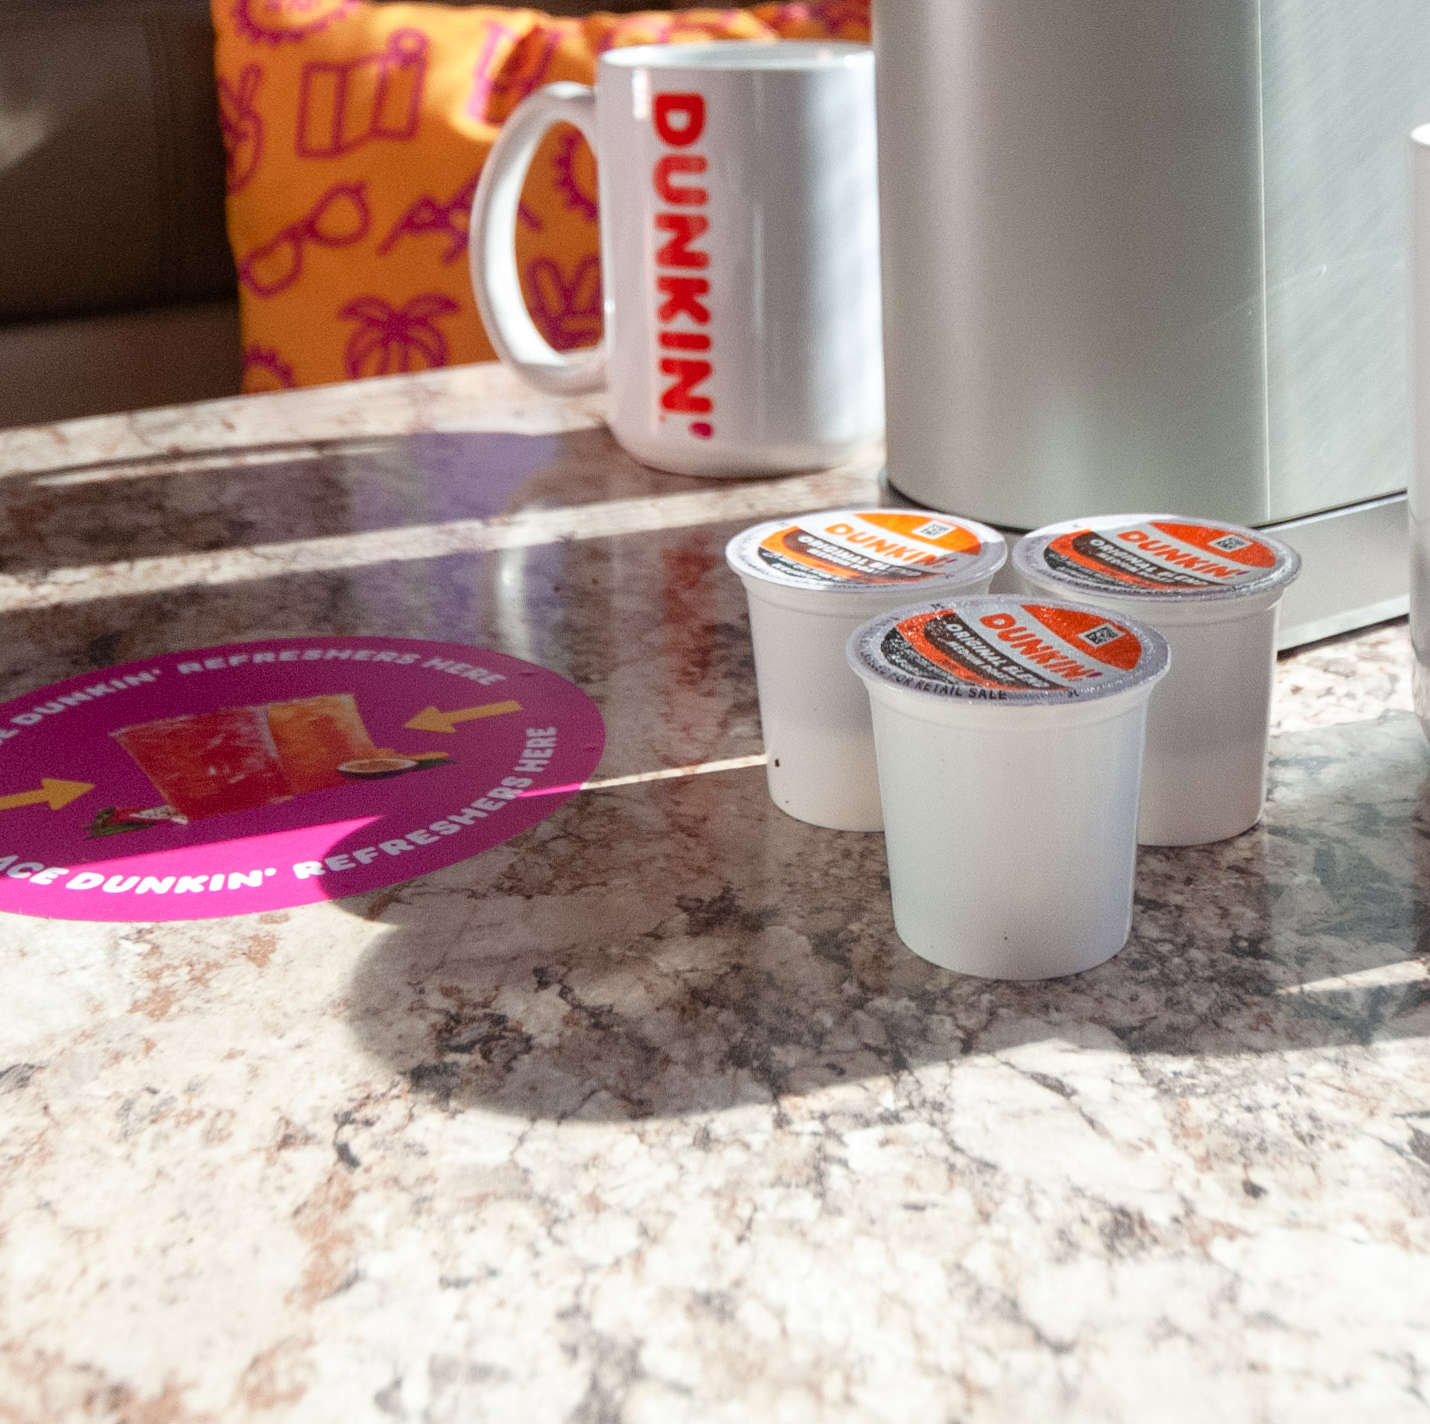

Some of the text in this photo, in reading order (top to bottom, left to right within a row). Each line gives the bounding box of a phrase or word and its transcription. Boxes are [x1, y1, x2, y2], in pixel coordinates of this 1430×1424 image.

[652, 92, 715, 440] DUNKIN'
[797, 535, 870, 565] ORIGINAL
[824, 522, 957, 569] DUNKIN'
[1089, 538, 1157, 573] ORIGINAL
[1116, 529, 1250, 580] DUNKIN'
[945, 623, 1007, 667] ORIGINAL
[978, 612, 1103, 683] DUNKIN'
[10, 667, 163, 726] DUNKIN'
[176, 648, 421, 675] REFRESHERS
[421, 656, 507, 686] HERE
[969, 688, 1008, 700] SALE
[65, 867, 277, 895] DUNKIN'
[292, 776, 533, 880] REFRESHERS
[513, 725, 558, 773] HERE
